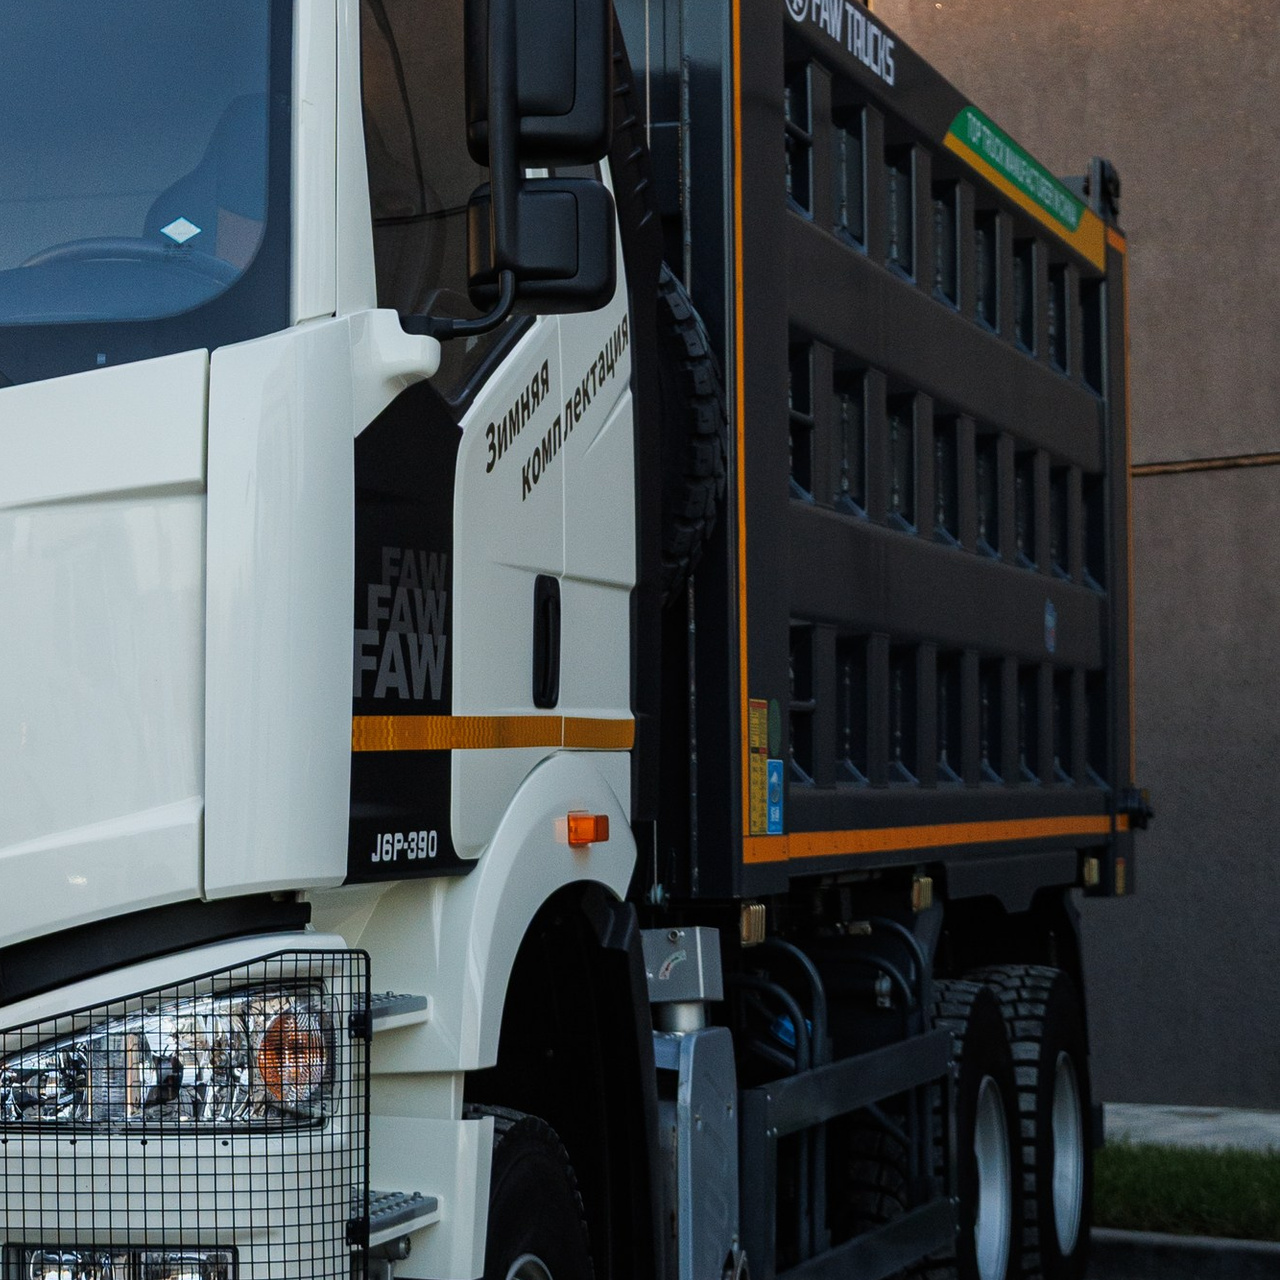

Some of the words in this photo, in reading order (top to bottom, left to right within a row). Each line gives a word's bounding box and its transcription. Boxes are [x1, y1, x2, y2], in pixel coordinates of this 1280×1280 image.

[845, 1, 895, 86] TRUCKS
[486, 357, 550, 474] Зимняя
[522, 312, 629, 502] комплектация
[382, 546, 448, 594] FAW
[367, 583, 448, 645] FAW
[353, 628, 448, 701] FAW
[371, 829, 438, 863] J6P-390
